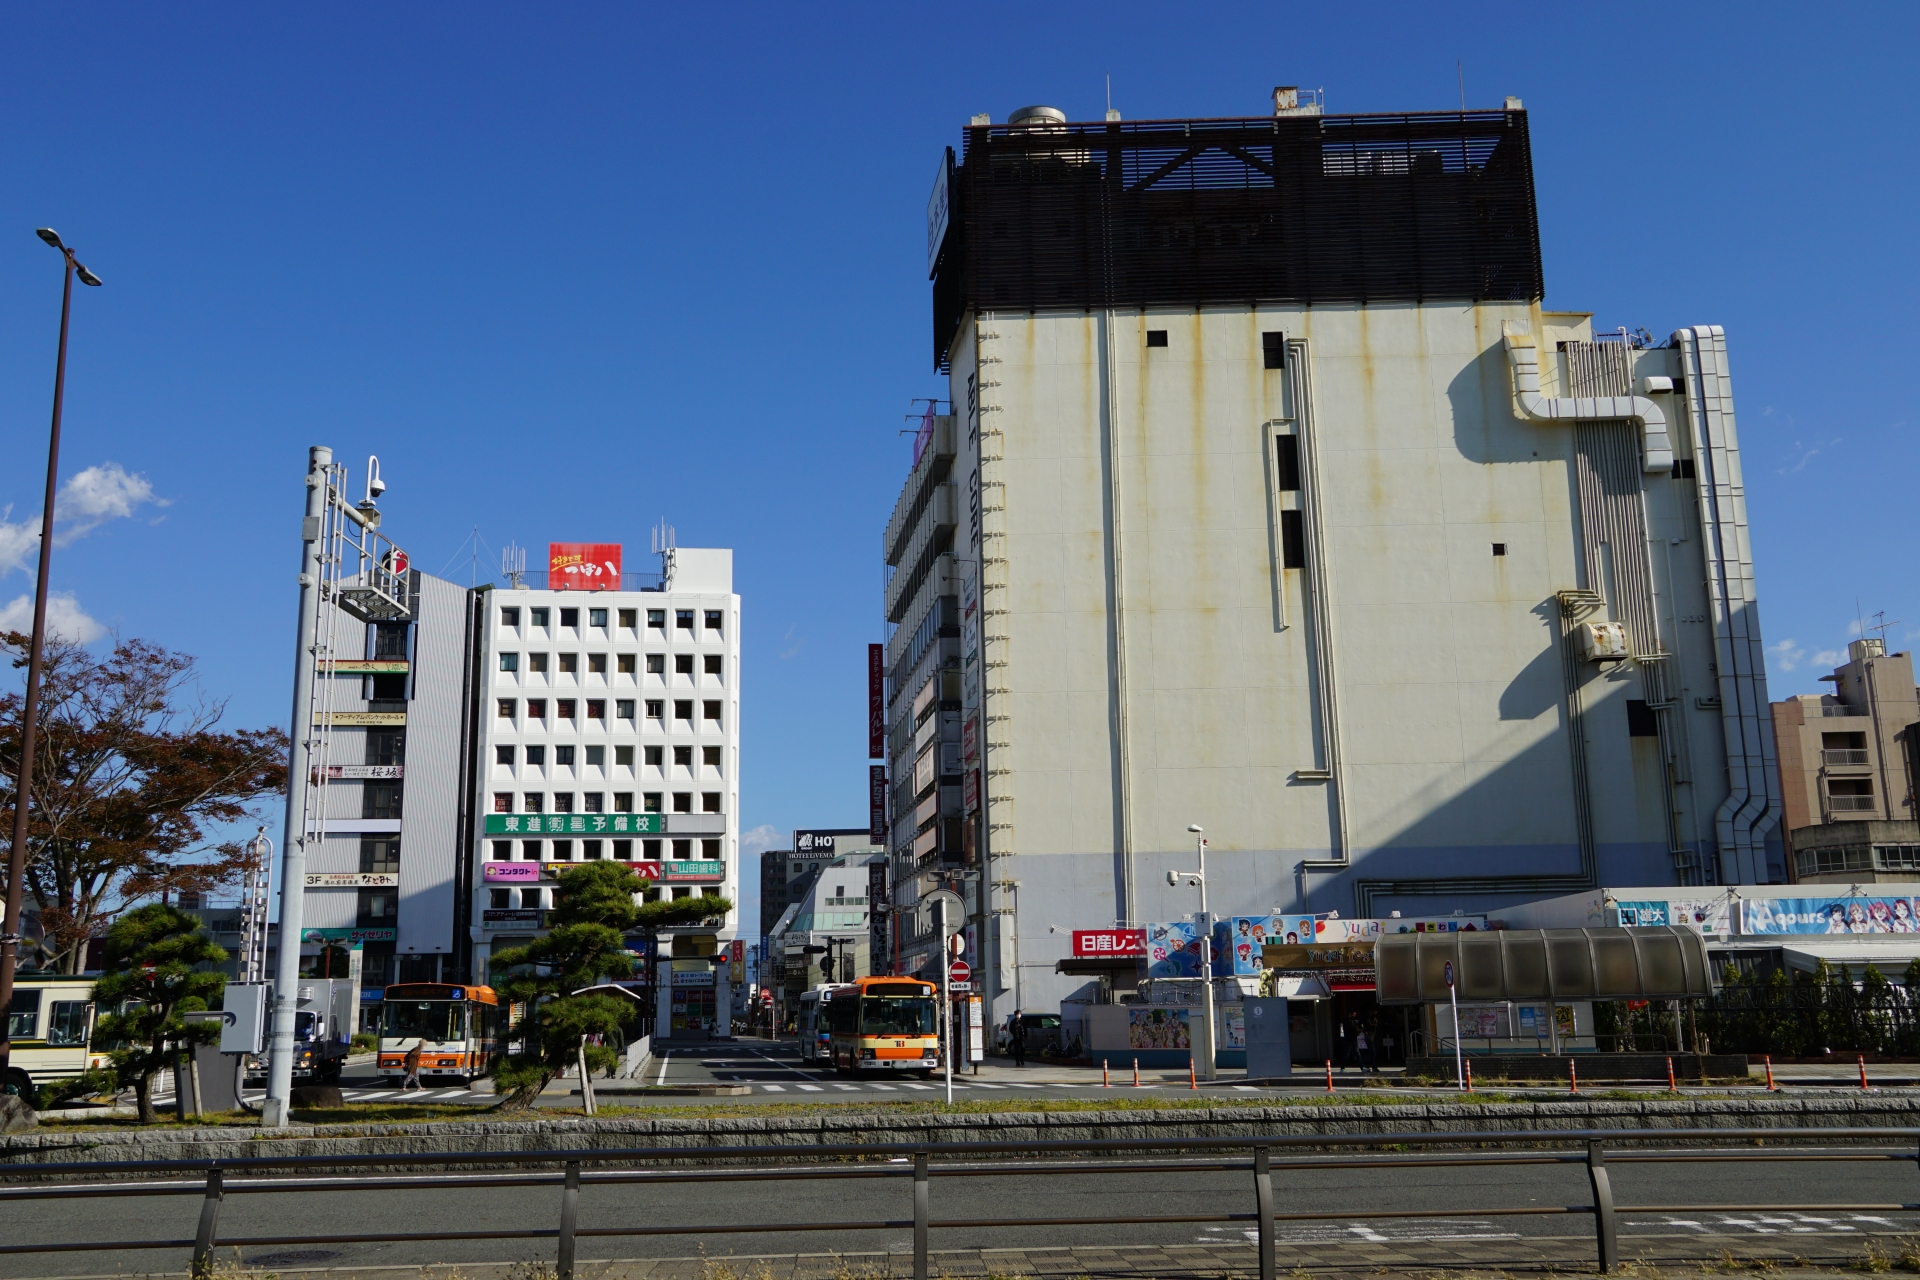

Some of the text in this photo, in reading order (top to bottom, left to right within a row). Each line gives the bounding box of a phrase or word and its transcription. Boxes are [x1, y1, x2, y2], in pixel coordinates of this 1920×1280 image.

[967, 372, 979, 553] ABLE CORE
[564, 561, 618, 577] つぼ八
[871, 745, 883, 753] 5F
[371, 766, 399, 778] 桜坂
[504, 816, 650, 832] 東進衛星予備校
[814, 835, 837, 847] HO
[872, 836, 885, 844] 3F
[678, 863, 719, 874] 山田歯科
[307, 875, 322, 885] 3F
[873, 915, 885, 923] 2F
[1639, 907, 1666, 921] 雄大
[1756, 905, 1826, 931] Aqours
[350, 930, 393, 940] サイゼリヤ
[1341, 921, 1386, 938] yudai
[1307, 949, 1345, 964] yudai
